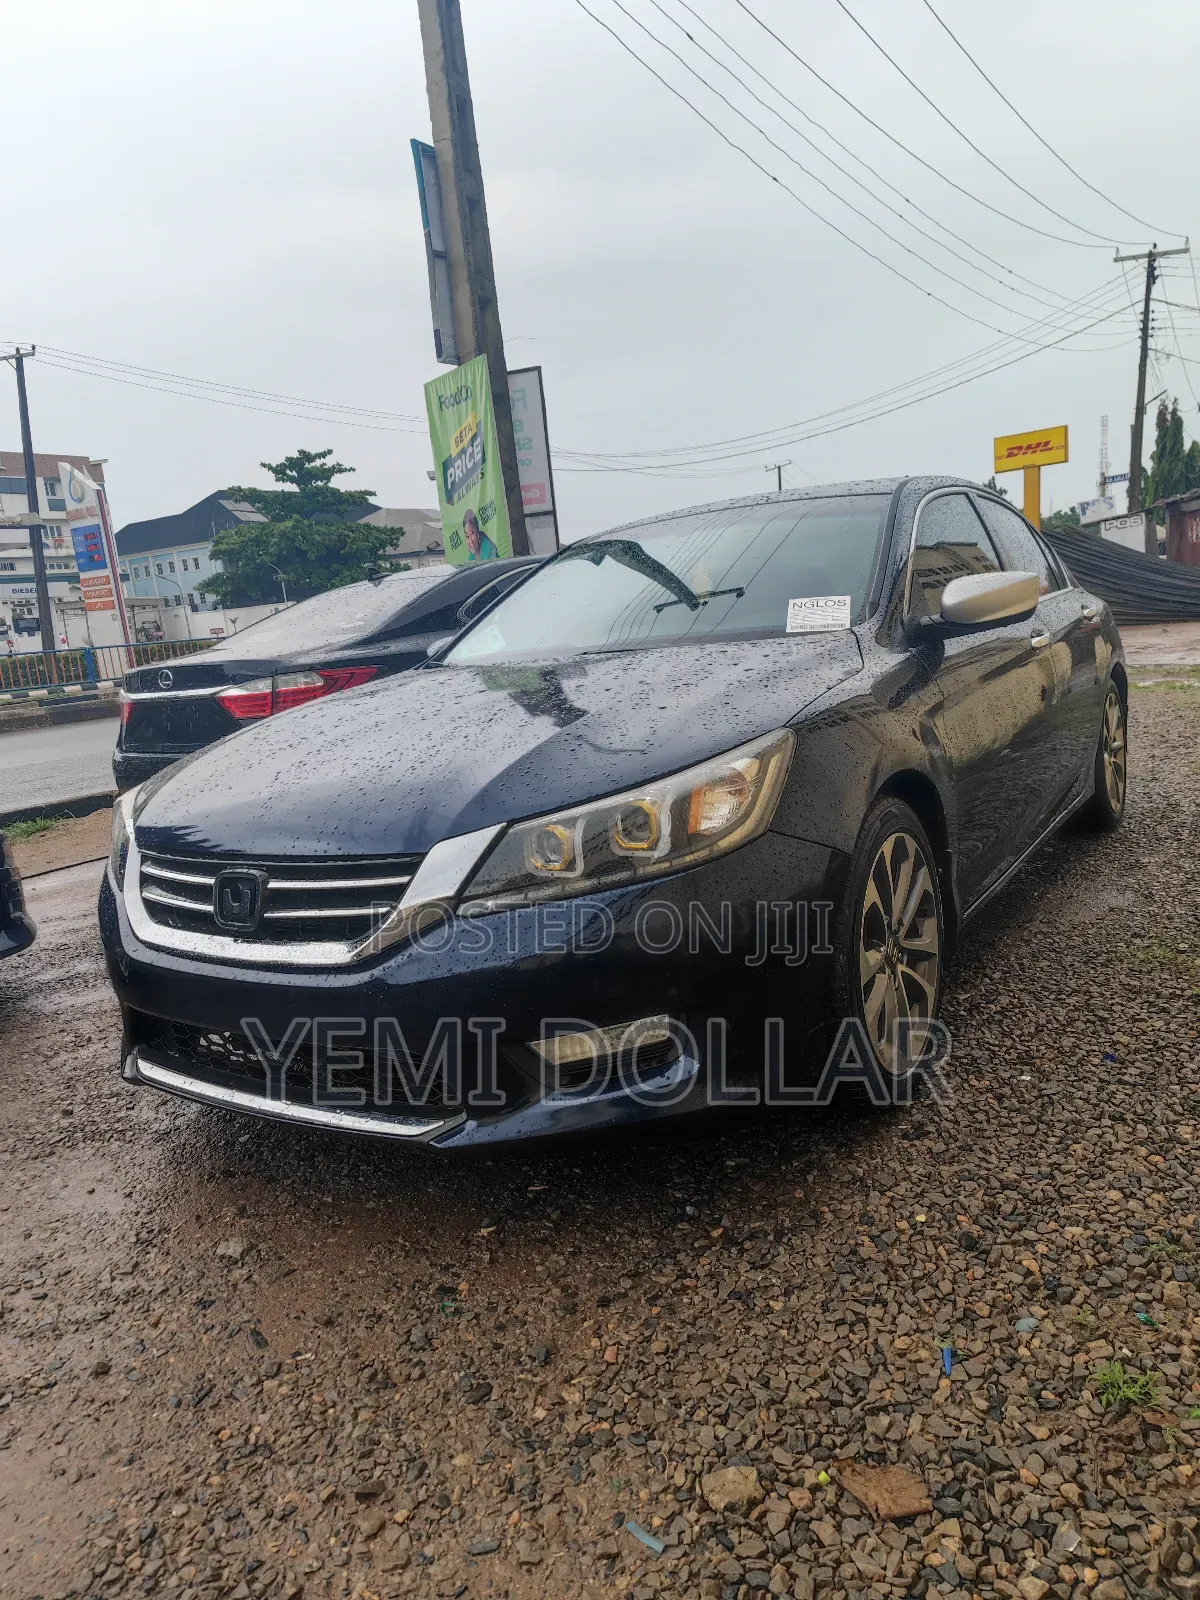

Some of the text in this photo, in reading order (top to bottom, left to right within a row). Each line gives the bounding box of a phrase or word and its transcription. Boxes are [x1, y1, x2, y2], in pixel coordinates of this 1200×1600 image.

[439, 384, 473, 411] FoodCo
[454, 421, 473, 448] BETA
[1005, 440, 1054, 458] DHL
[447, 436, 482, 490] PRICE
[456, 467, 485, 504] ALWAYS
[1105, 514, 1143, 531] POS
[792, 599, 847, 609] NGLOS
